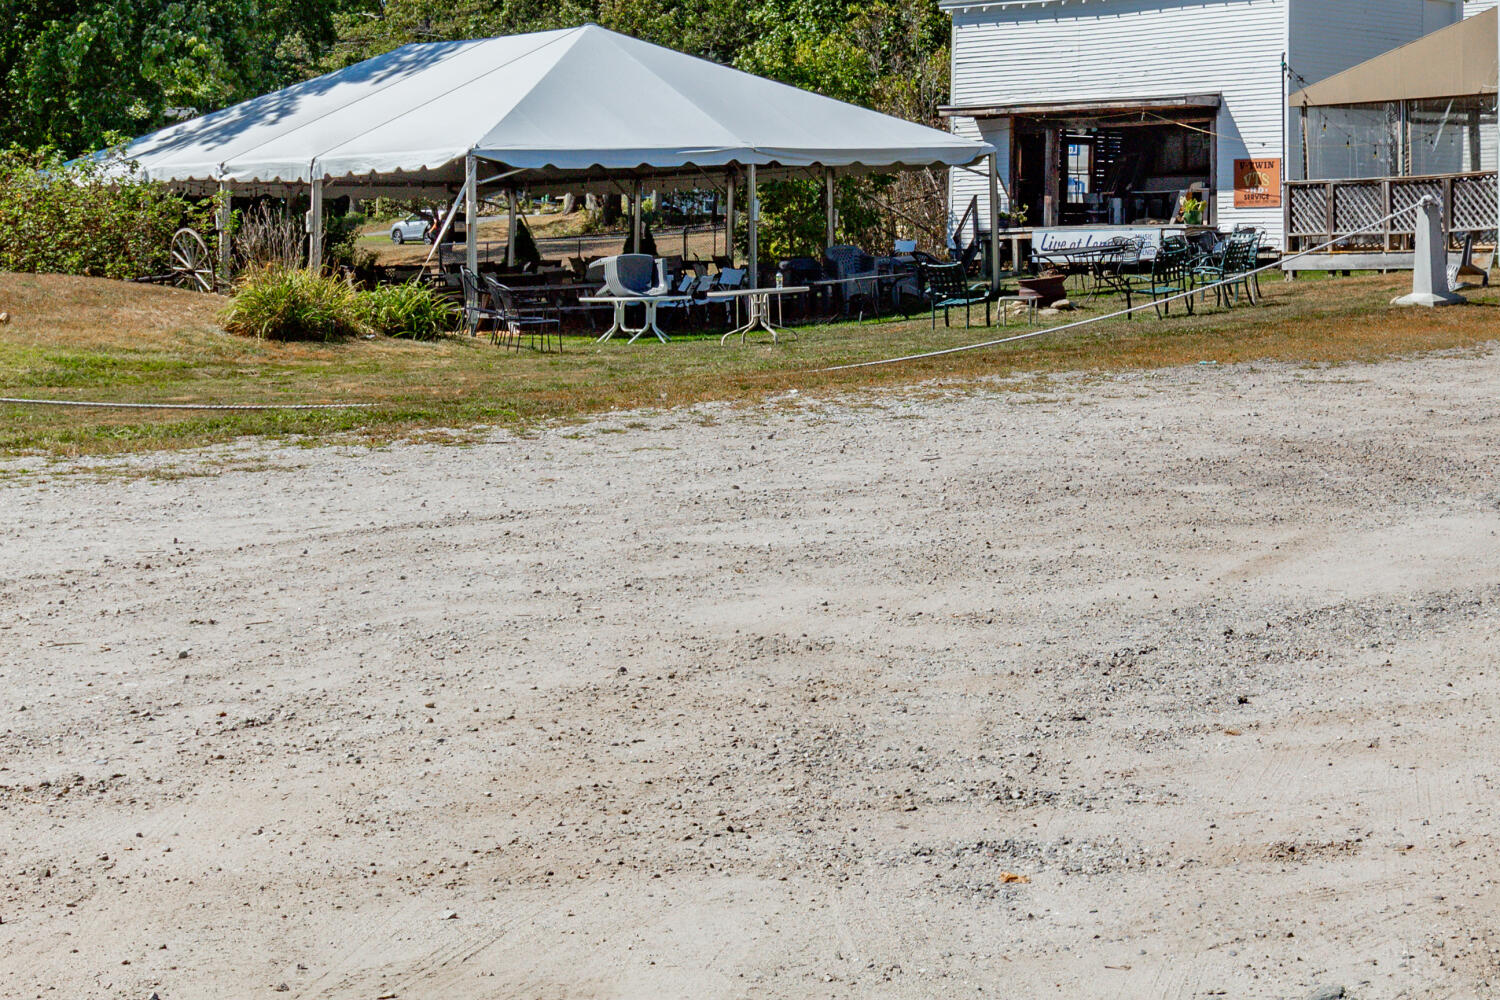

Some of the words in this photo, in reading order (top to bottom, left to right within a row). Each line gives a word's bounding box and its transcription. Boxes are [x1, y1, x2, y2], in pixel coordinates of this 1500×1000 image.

[1244, 193, 1269, 201] SERVICE
[1040, 233, 1067, 251] Live
[1070, 238, 1082, 249] at
